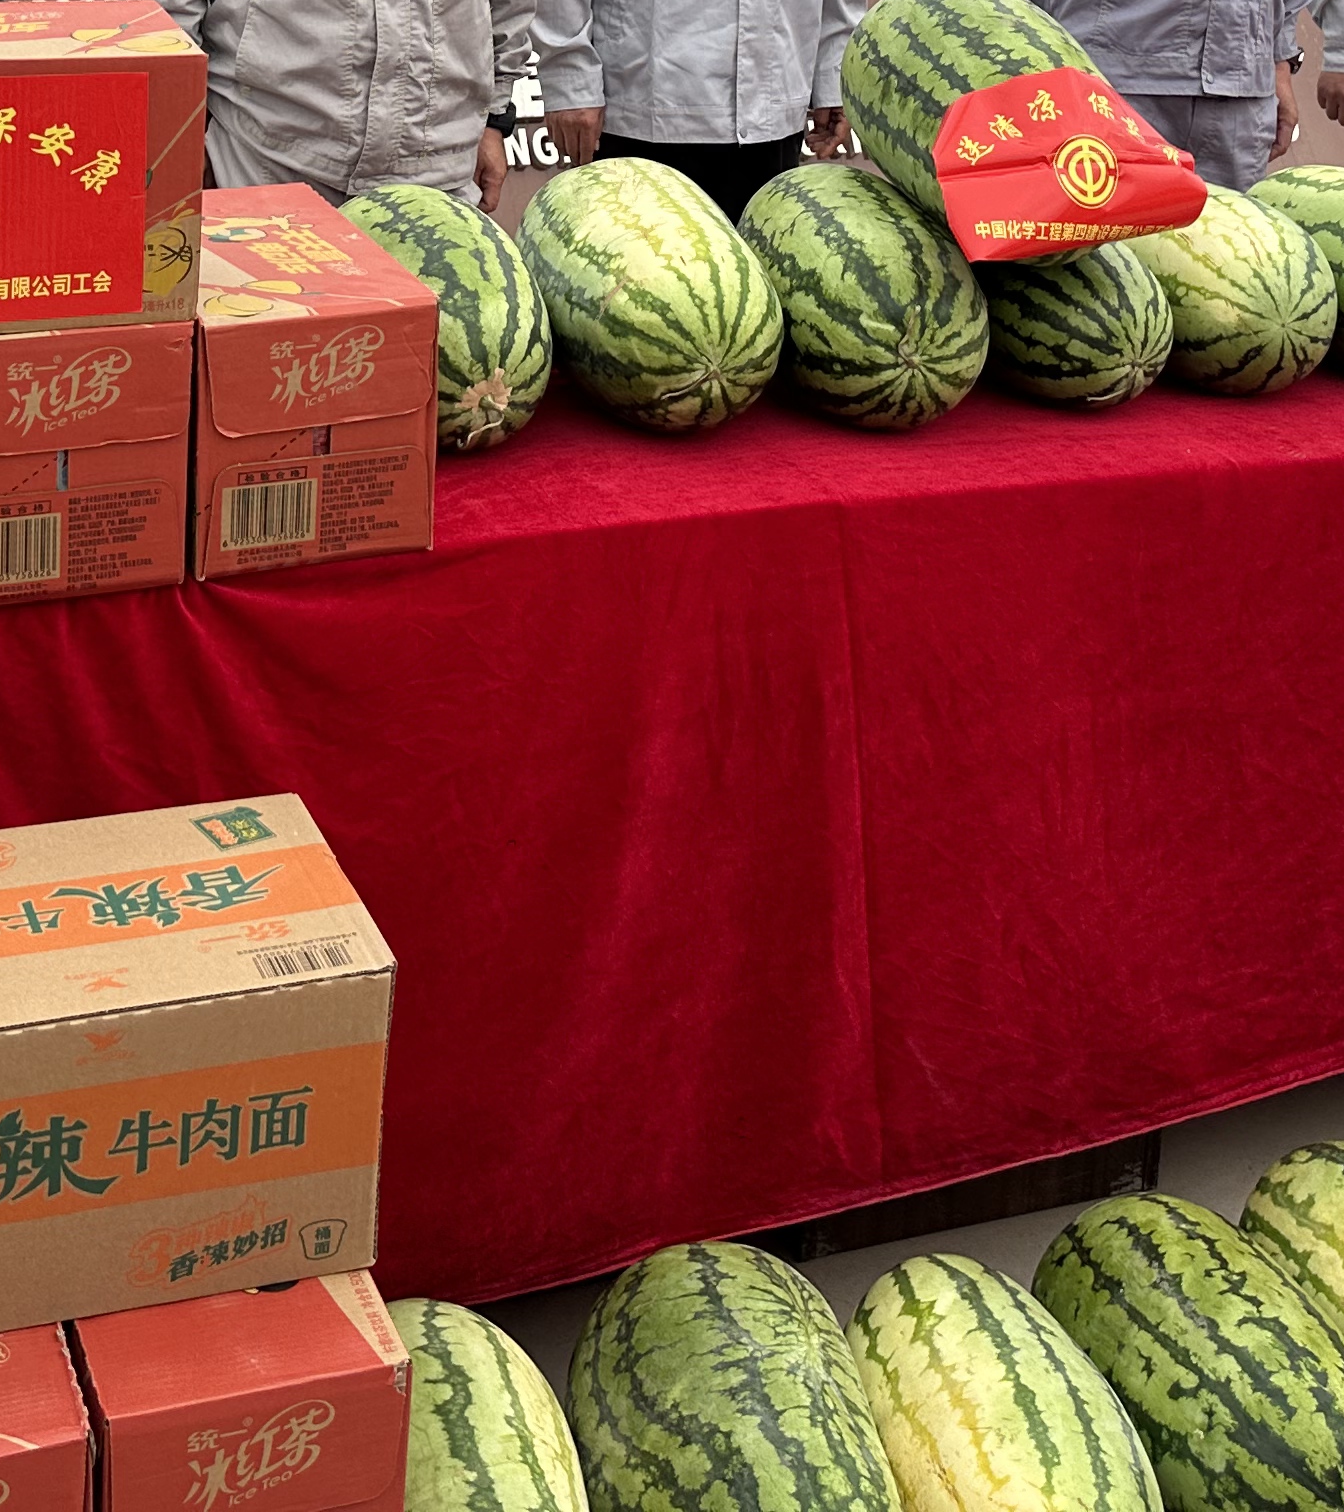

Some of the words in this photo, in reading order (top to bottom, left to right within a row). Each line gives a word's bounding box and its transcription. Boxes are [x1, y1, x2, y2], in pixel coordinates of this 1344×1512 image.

[956, 89, 1063, 166] 送清凉
[7, 361, 57, 382] 统一
[269, 339, 317, 361] 统一
[269, 324, 385, 416] 冰红茶
[5, 346, 132, 442] 冰红茶
[313, 1226, 333, 1255] 桶面
[183, 1400, 336, 1512] 冰红茶
[188, 1429, 246, 1455] 统一
